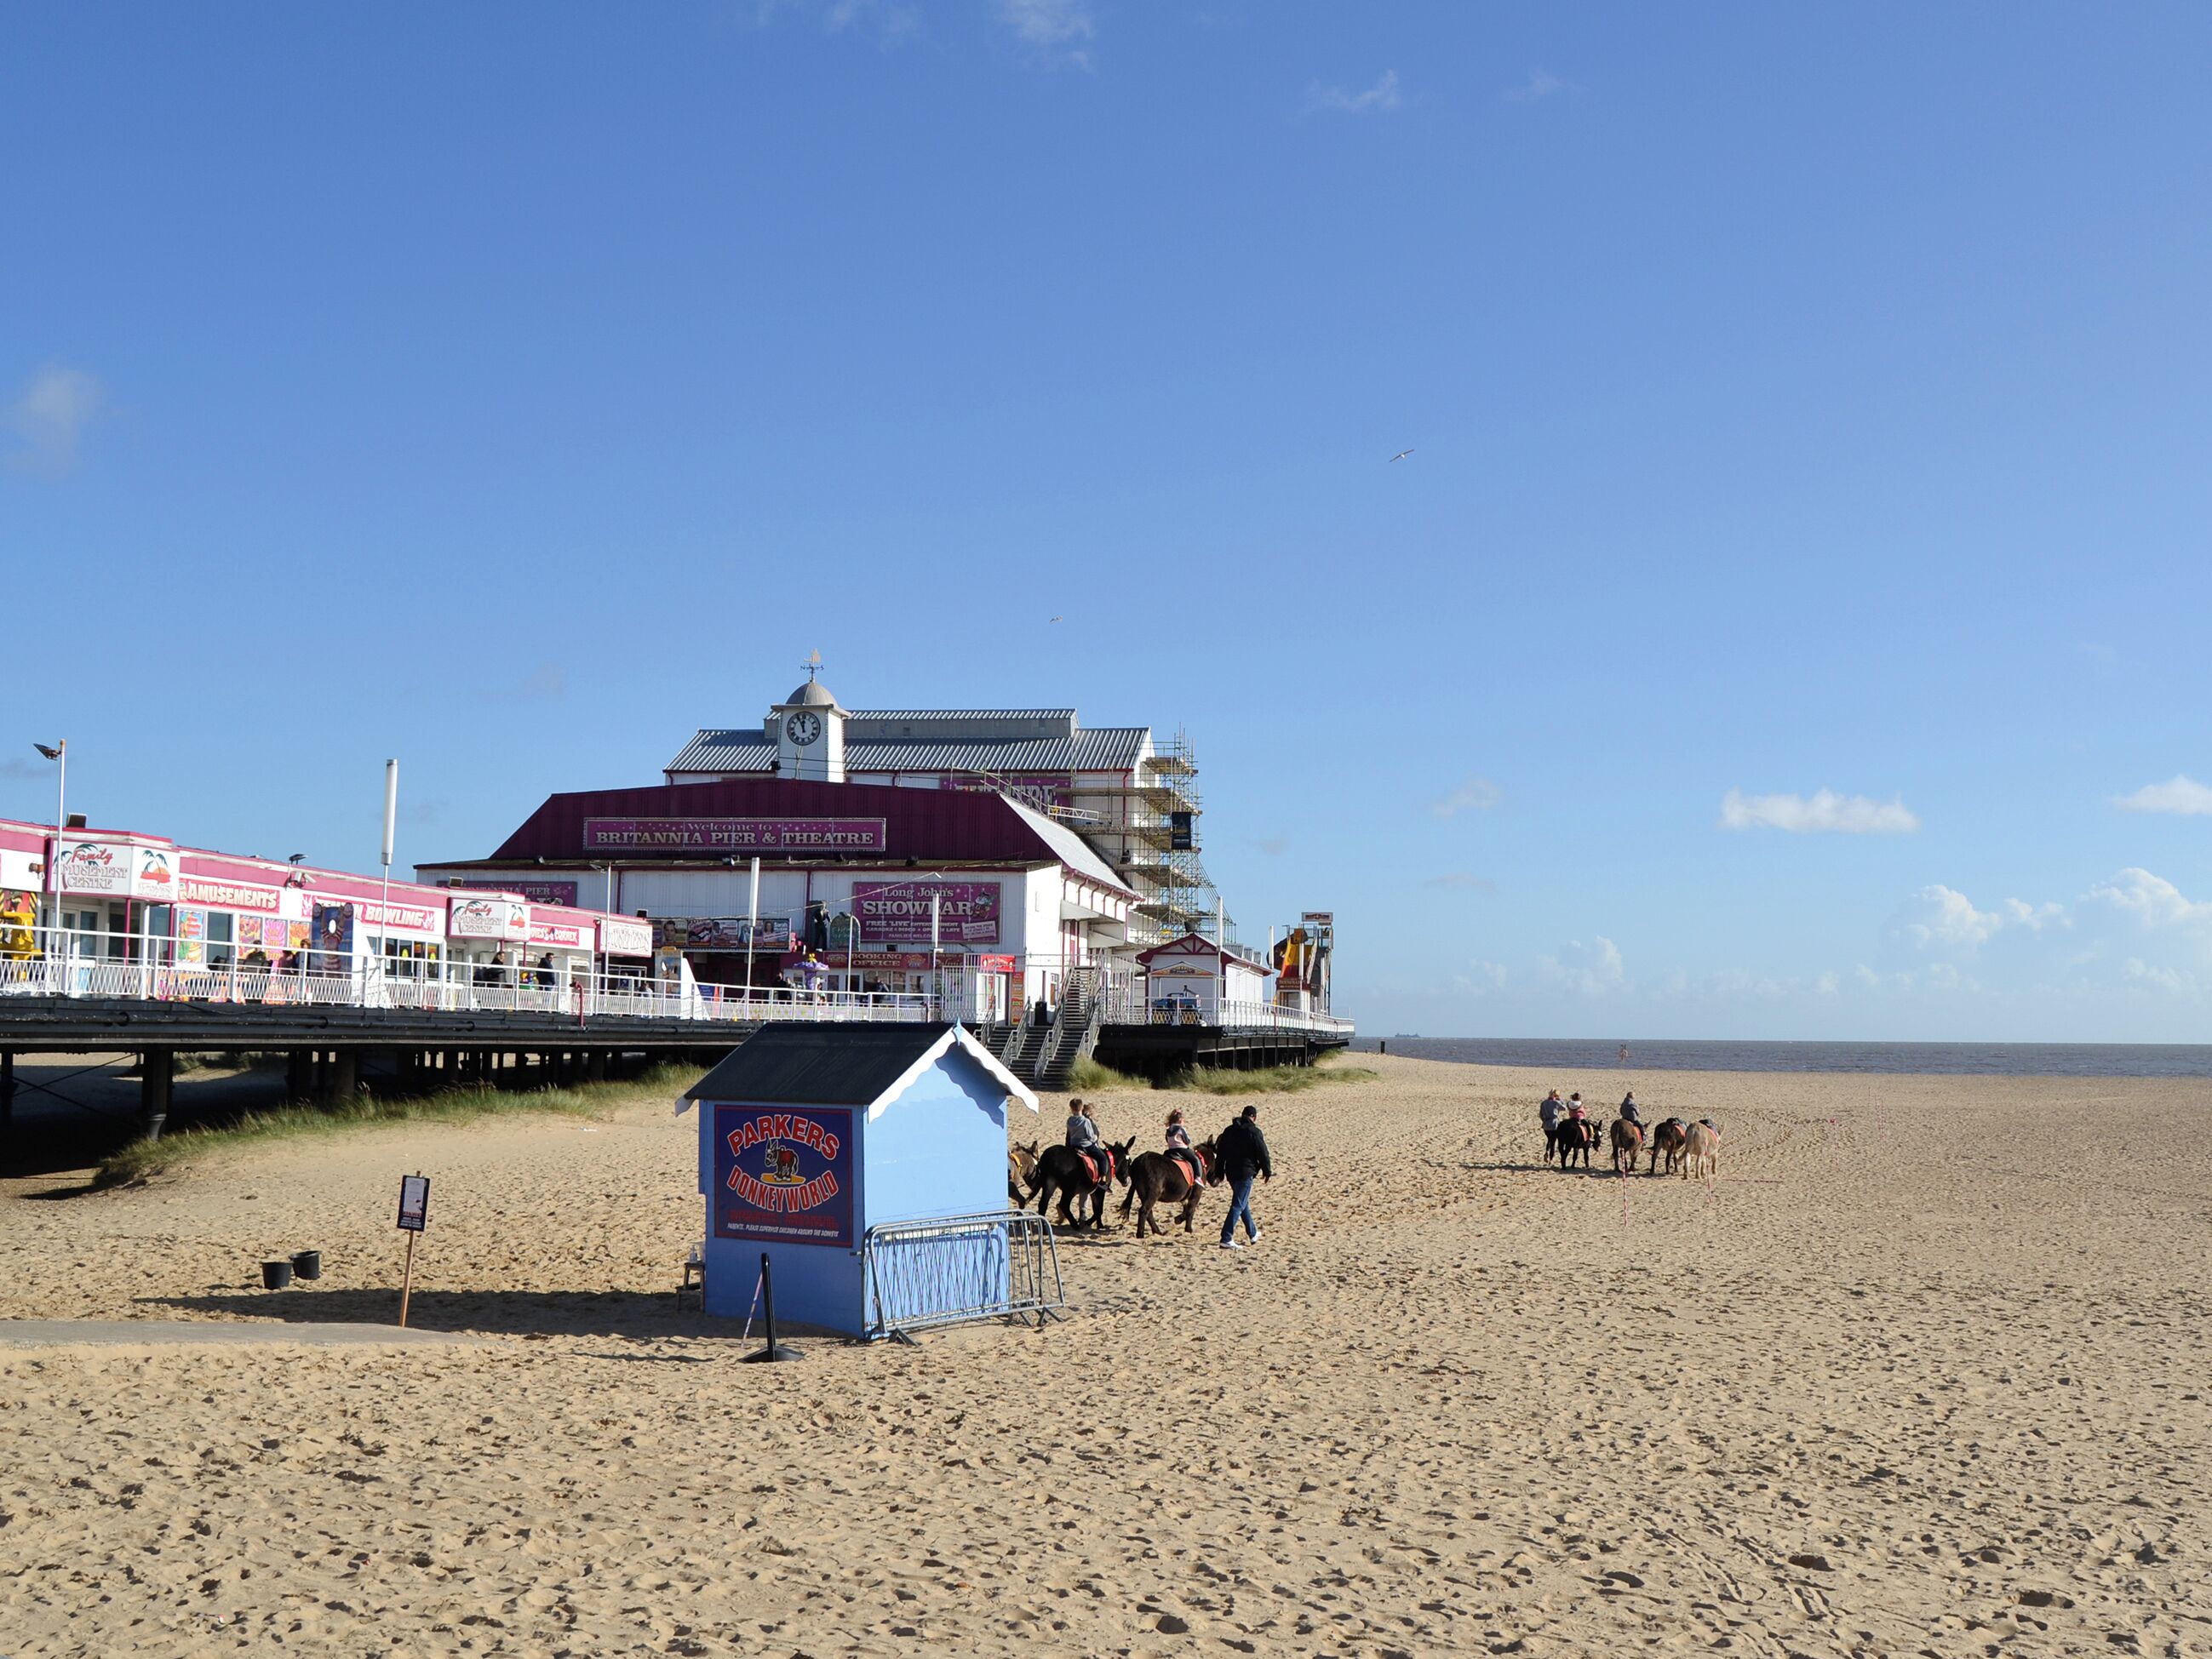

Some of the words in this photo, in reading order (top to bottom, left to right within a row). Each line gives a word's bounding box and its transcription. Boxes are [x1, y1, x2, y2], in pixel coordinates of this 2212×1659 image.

[688, 822, 754, 832] Welcome
[759, 823, 772, 832] to
[596, 832, 704, 844] BRITANNIA
[710, 832, 757, 844] PIER
[762, 832, 776, 844] &
[782, 832, 874, 844] THEATRE
[72, 848, 112, 865] Family
[66, 877, 112, 890] CENTRE
[187, 882, 278, 909] AMUSEMENTS
[526, 887, 551, 896] PIER
[885, 888, 914, 899] Long
[919, 888, 954, 897] John's
[366, 904, 425, 927] BOWLING
[464, 903, 492, 916] Family
[727, 1114, 840, 1160] PARKERS
